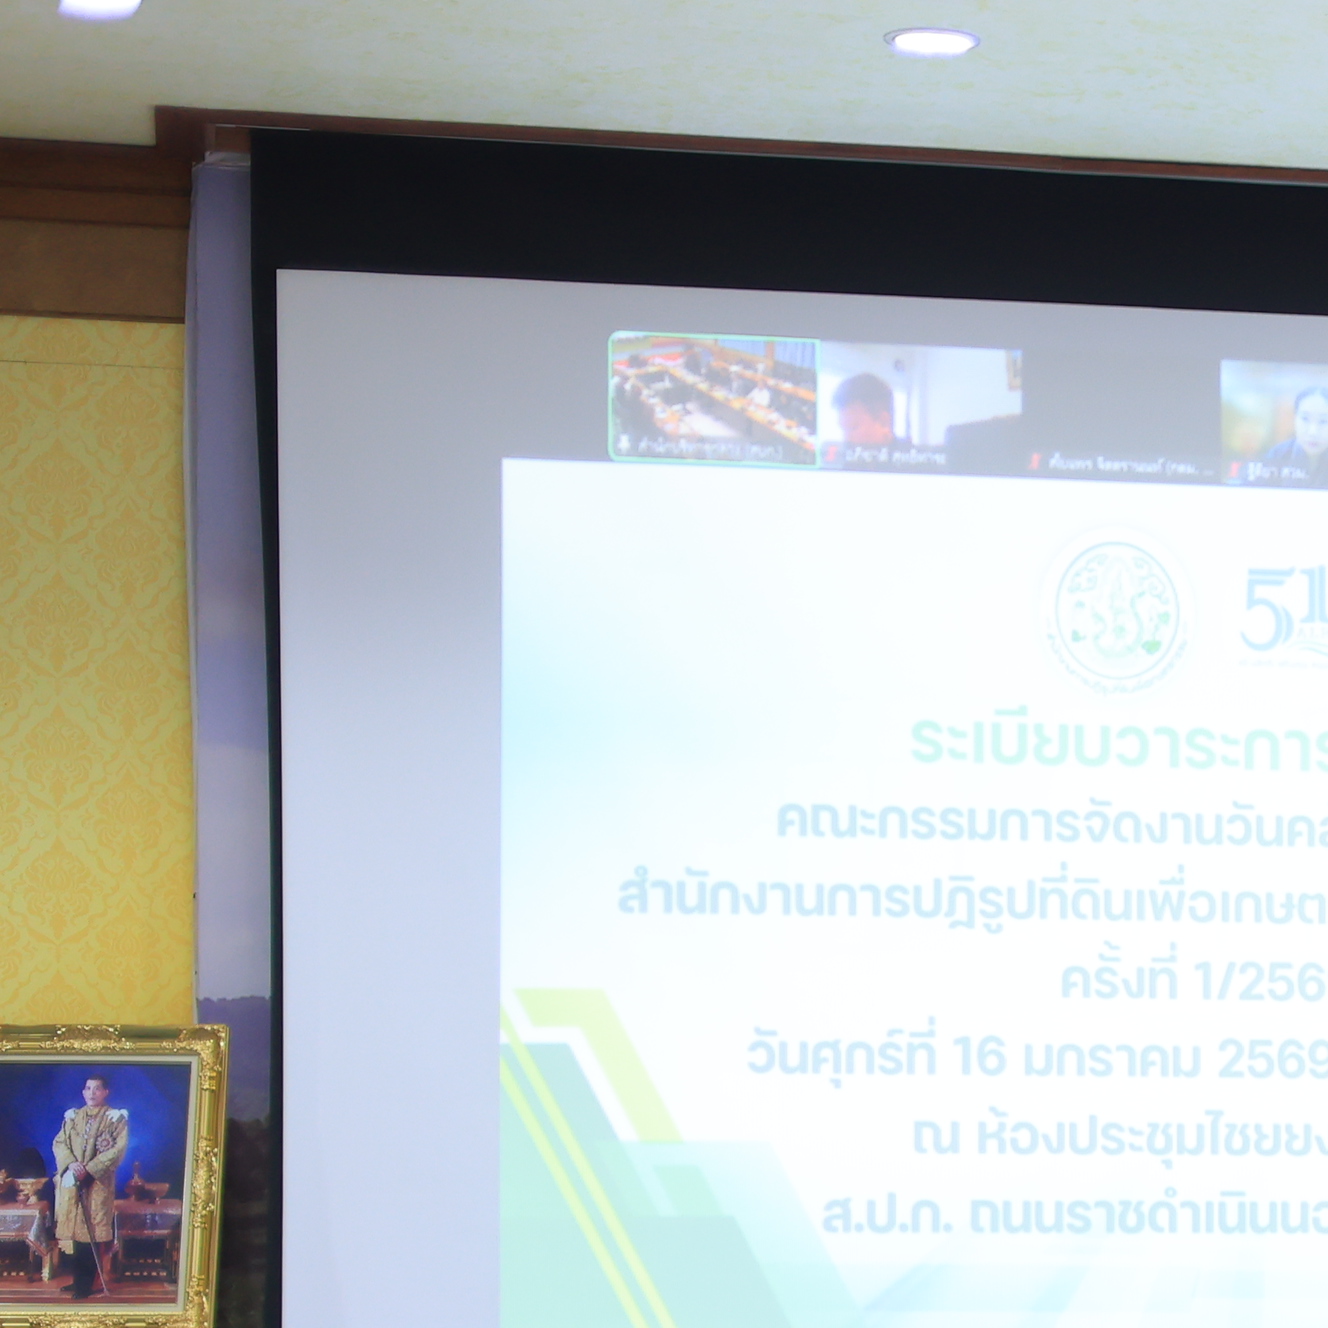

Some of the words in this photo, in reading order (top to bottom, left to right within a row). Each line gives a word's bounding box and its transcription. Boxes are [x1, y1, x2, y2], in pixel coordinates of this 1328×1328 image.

[1061, 940, 1178, 1000] ครั้งที่
[747, 1015, 937, 1089] วันศุกร์ที่
[953, 1035, 1007, 1077] 16
[1024, 1043, 1201, 1078] มกราคม
[913, 1120, 960, 1155] ณ
[823, 1192, 953, 1234] ส.ป.ก.
